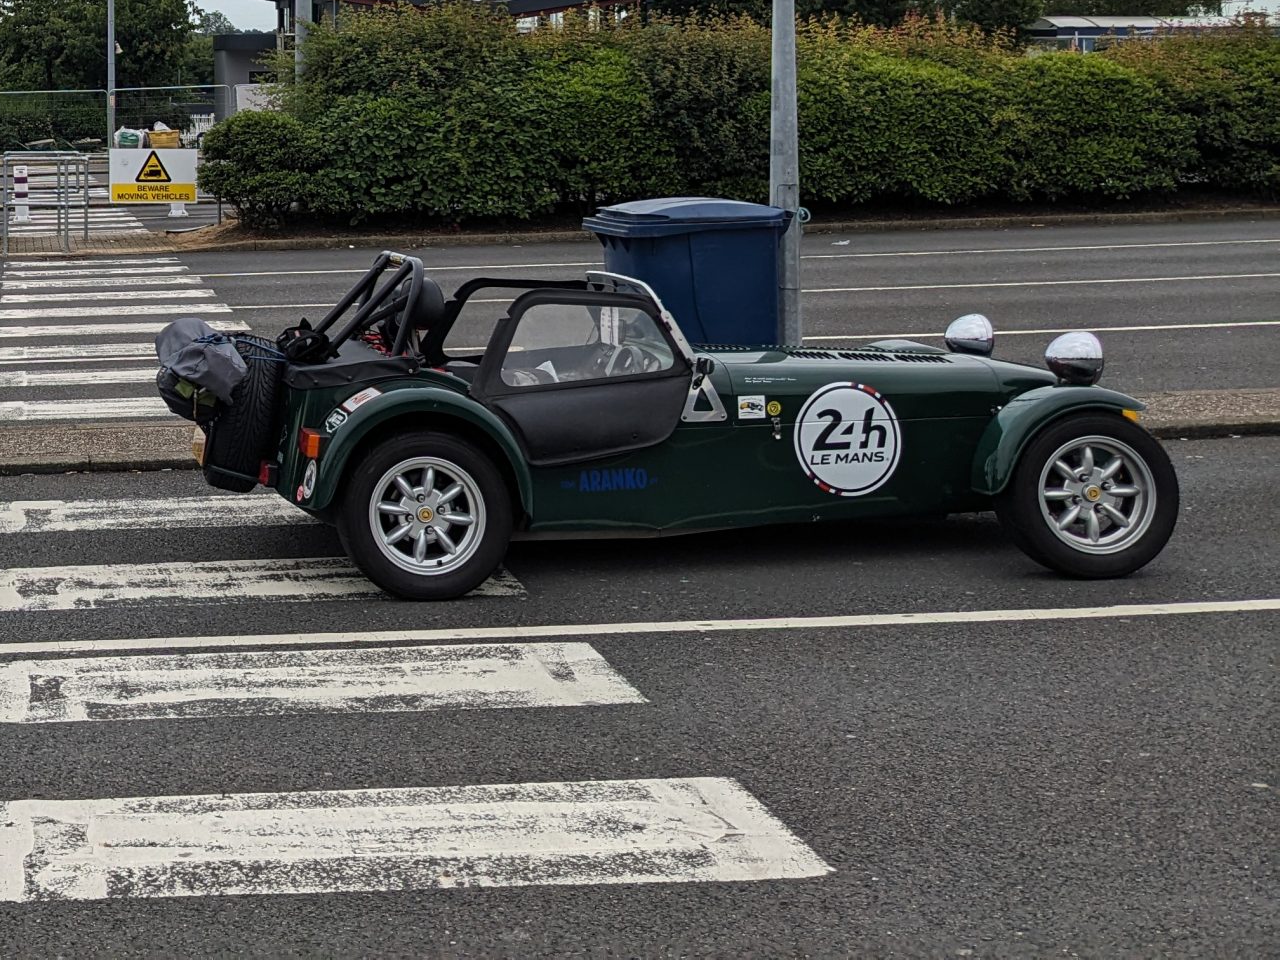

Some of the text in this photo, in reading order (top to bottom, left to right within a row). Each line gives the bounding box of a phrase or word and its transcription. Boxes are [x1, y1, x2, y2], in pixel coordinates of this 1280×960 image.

[812, 406, 887, 451] 24h
[810, 451, 885, 466] LE MANS
[579, 467, 648, 493] ARANKO
